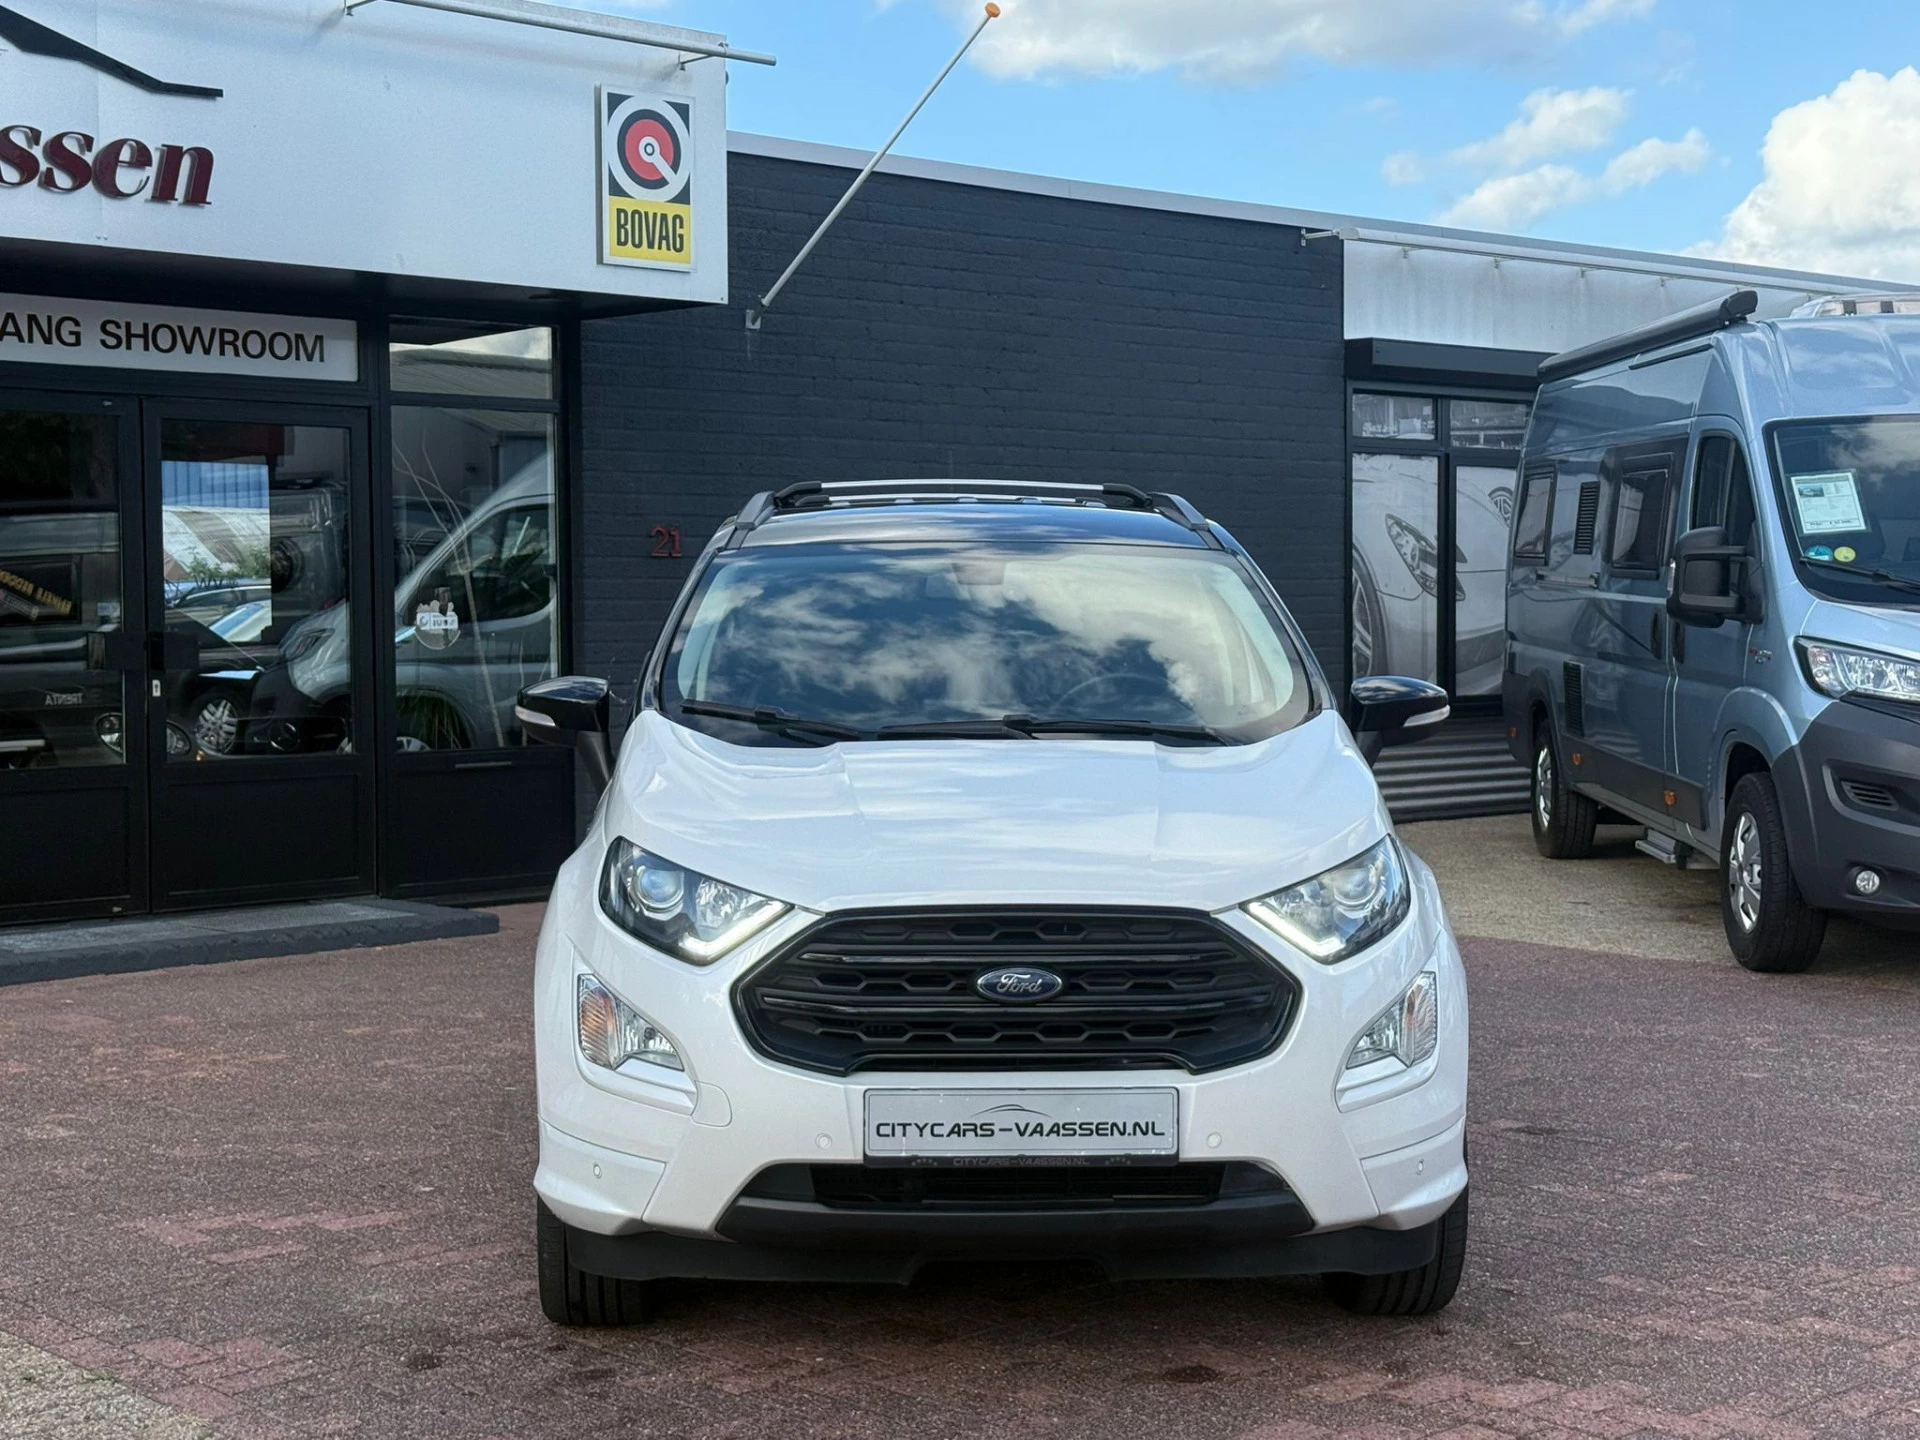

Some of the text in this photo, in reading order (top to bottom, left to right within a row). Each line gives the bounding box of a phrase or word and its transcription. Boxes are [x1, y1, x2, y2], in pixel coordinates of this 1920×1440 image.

[0, 124, 214, 206] ssen
[616, 207, 685, 253] BOVAG
[0, 311, 325, 363] ANG SHOWROOM
[649, 525, 682, 557] 21
[996, 973, 1043, 993] Ford
[876, 1121, 1166, 1138] CITYCARS-VAASSEN.NL
[953, 1157, 1090, 1167] CITYCARS-VAASSEN.NL
